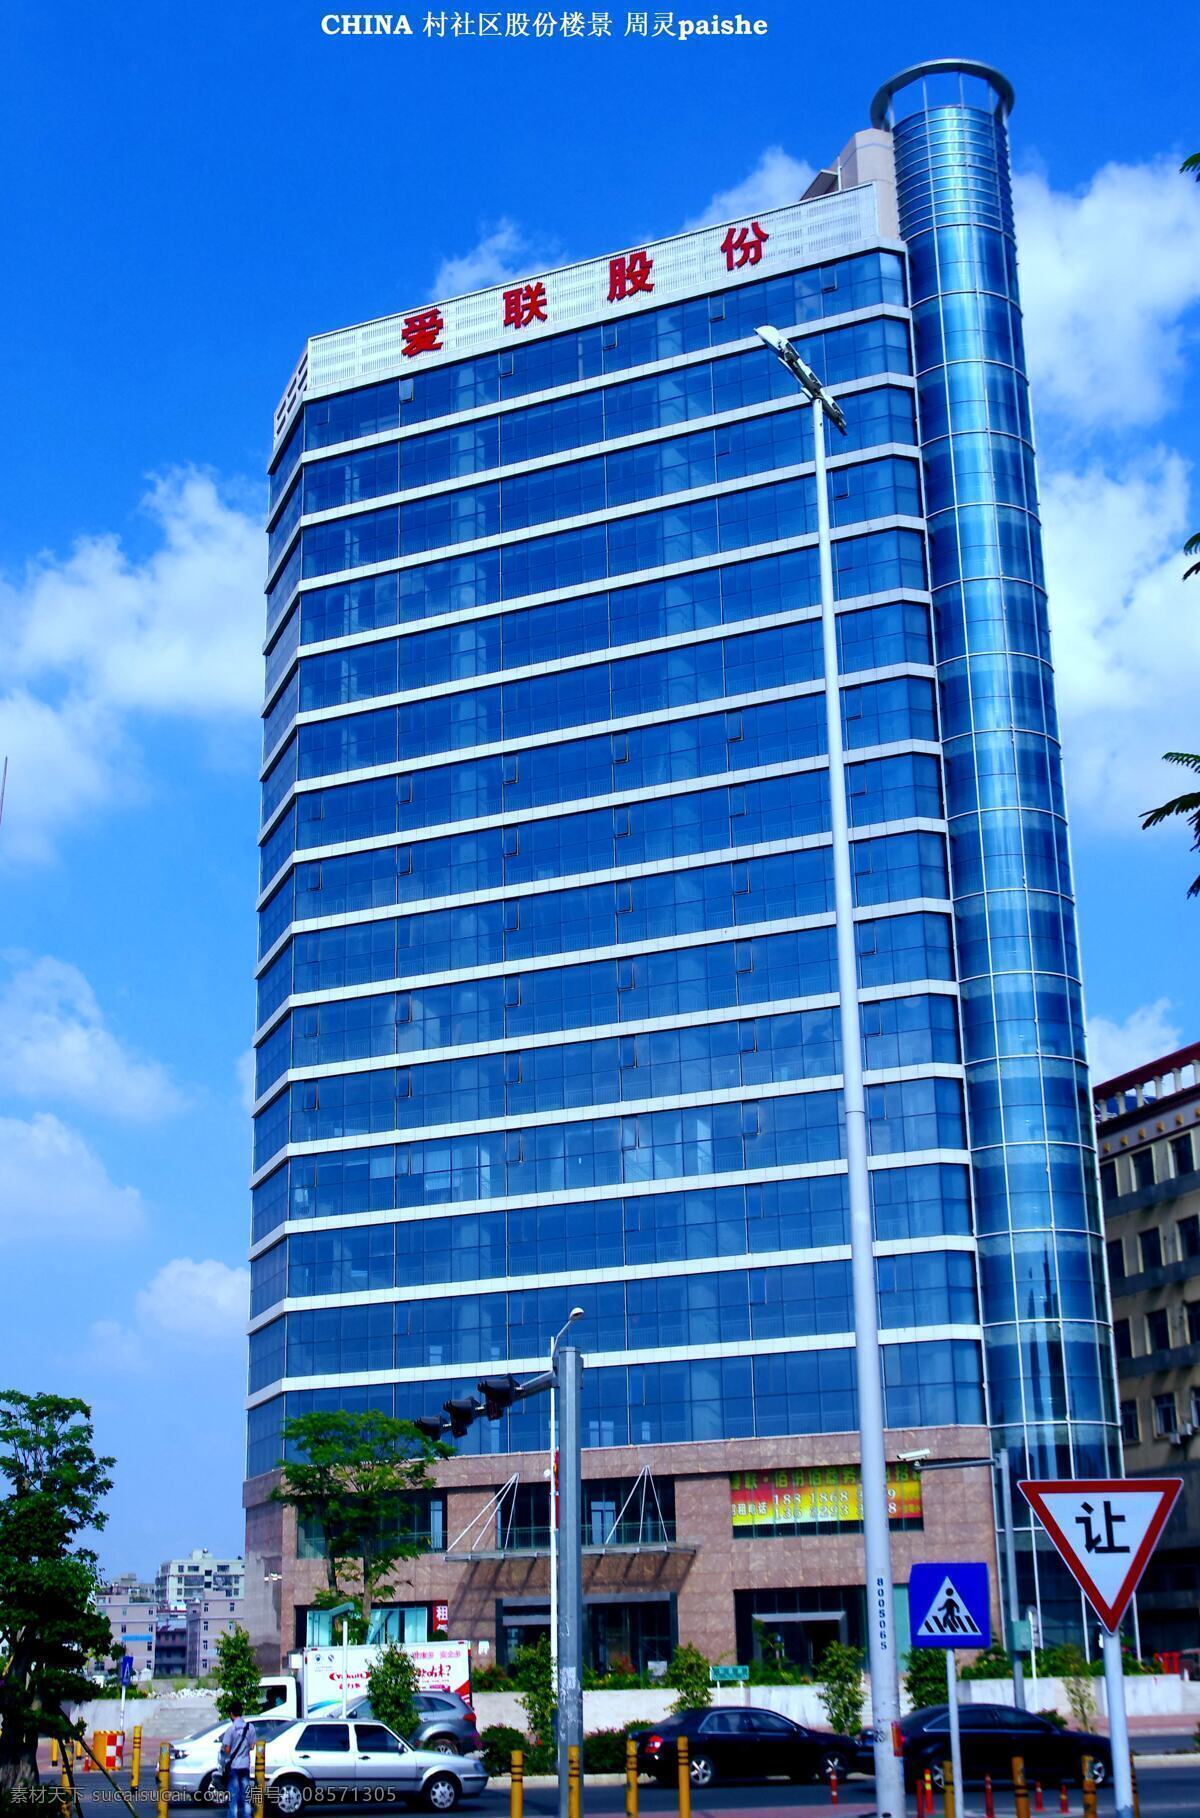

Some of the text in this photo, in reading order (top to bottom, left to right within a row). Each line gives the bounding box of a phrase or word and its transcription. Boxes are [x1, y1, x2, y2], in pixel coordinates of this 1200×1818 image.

[400, 220, 770, 358] 爱联股份
[1075, 1501, 1130, 1553] 让
